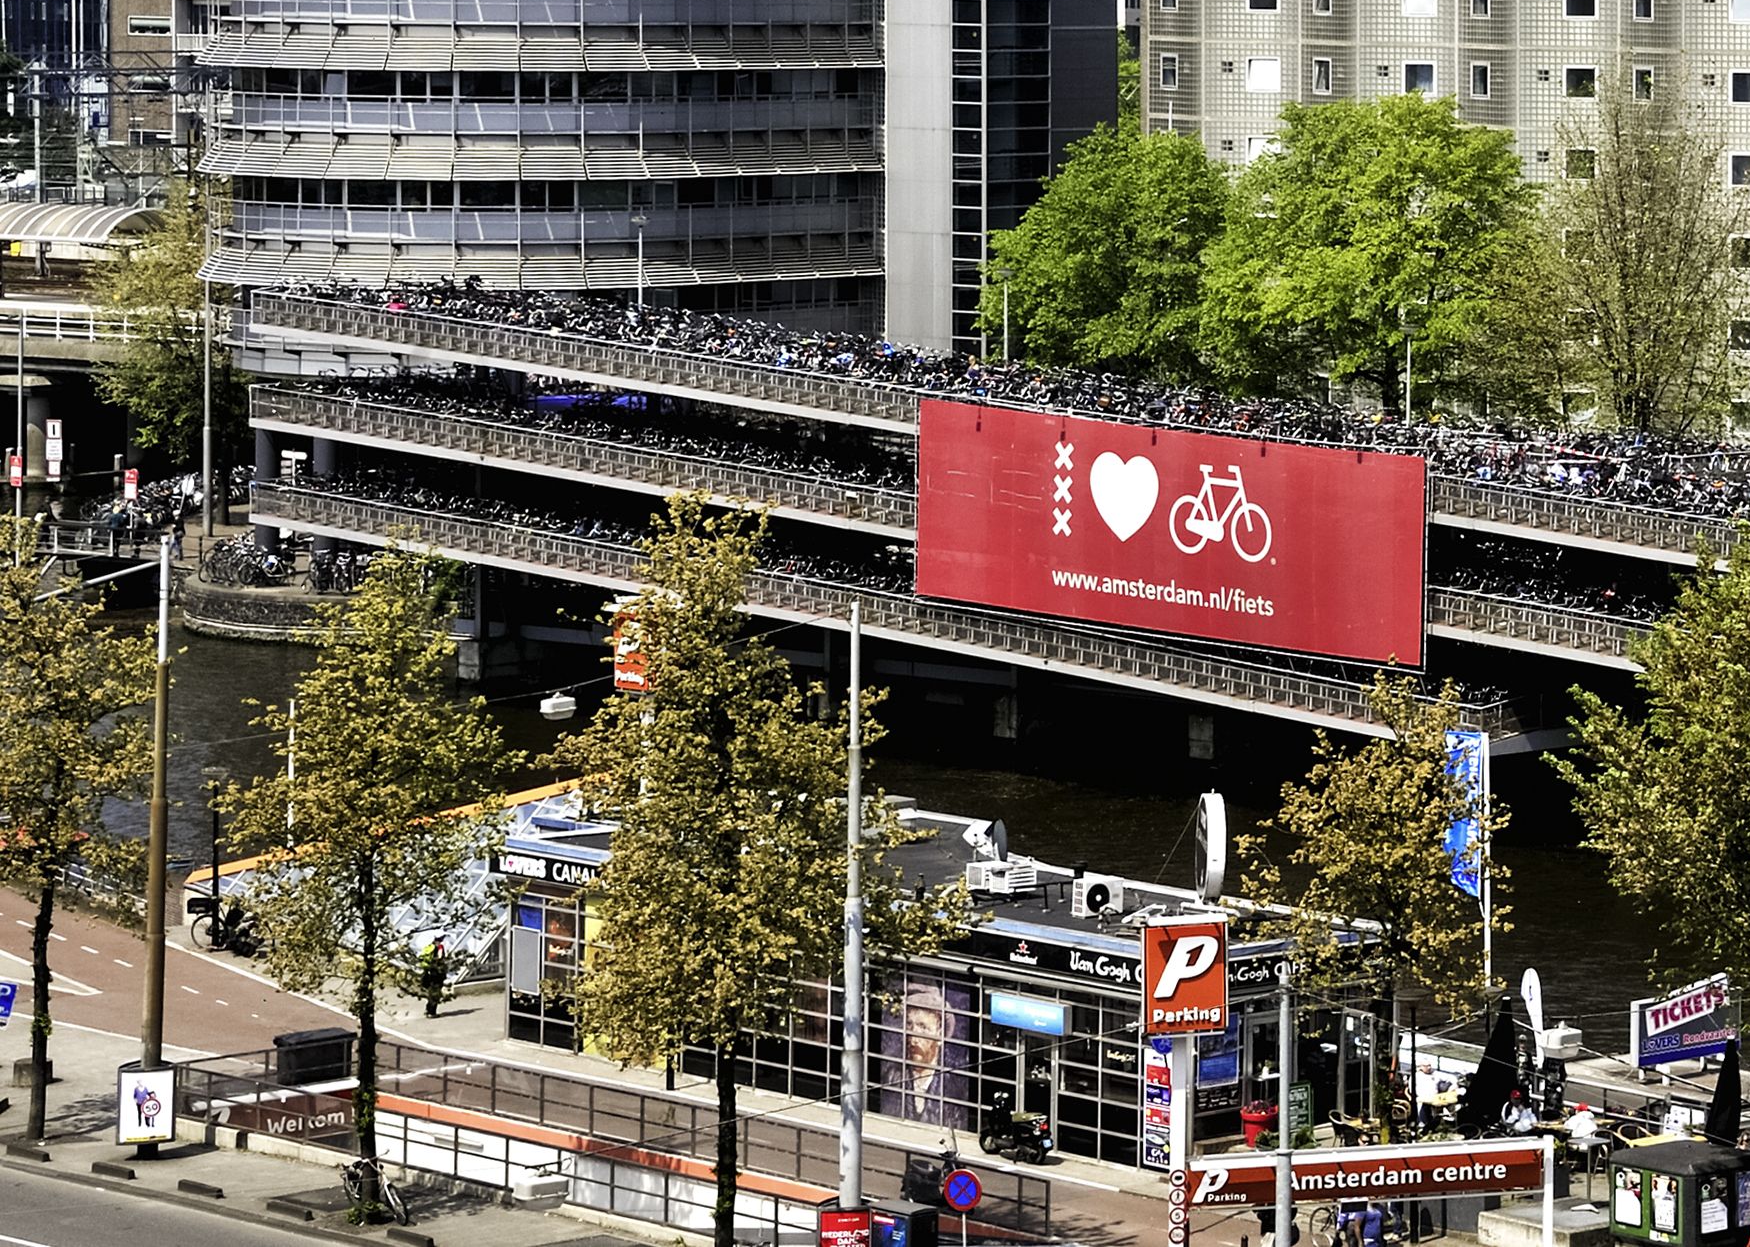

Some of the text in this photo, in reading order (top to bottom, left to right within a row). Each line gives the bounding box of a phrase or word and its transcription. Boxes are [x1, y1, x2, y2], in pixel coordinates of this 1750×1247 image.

[1052, 569, 1275, 617] www.amsterdam.nl/fiets
[1070, 950, 1094, 974] Van
[1095, 956, 1130, 983] Gogh
[1237, 965, 1270, 982] Gogh
[1153, 1006, 1221, 1025] Parking
[1651, 985, 1724, 1030] TICKETS
[1642, 1035, 1680, 1053] LOVERS
[1432, 1163, 1507, 1182] centre
[1207, 1193, 1247, 1203] Parking
